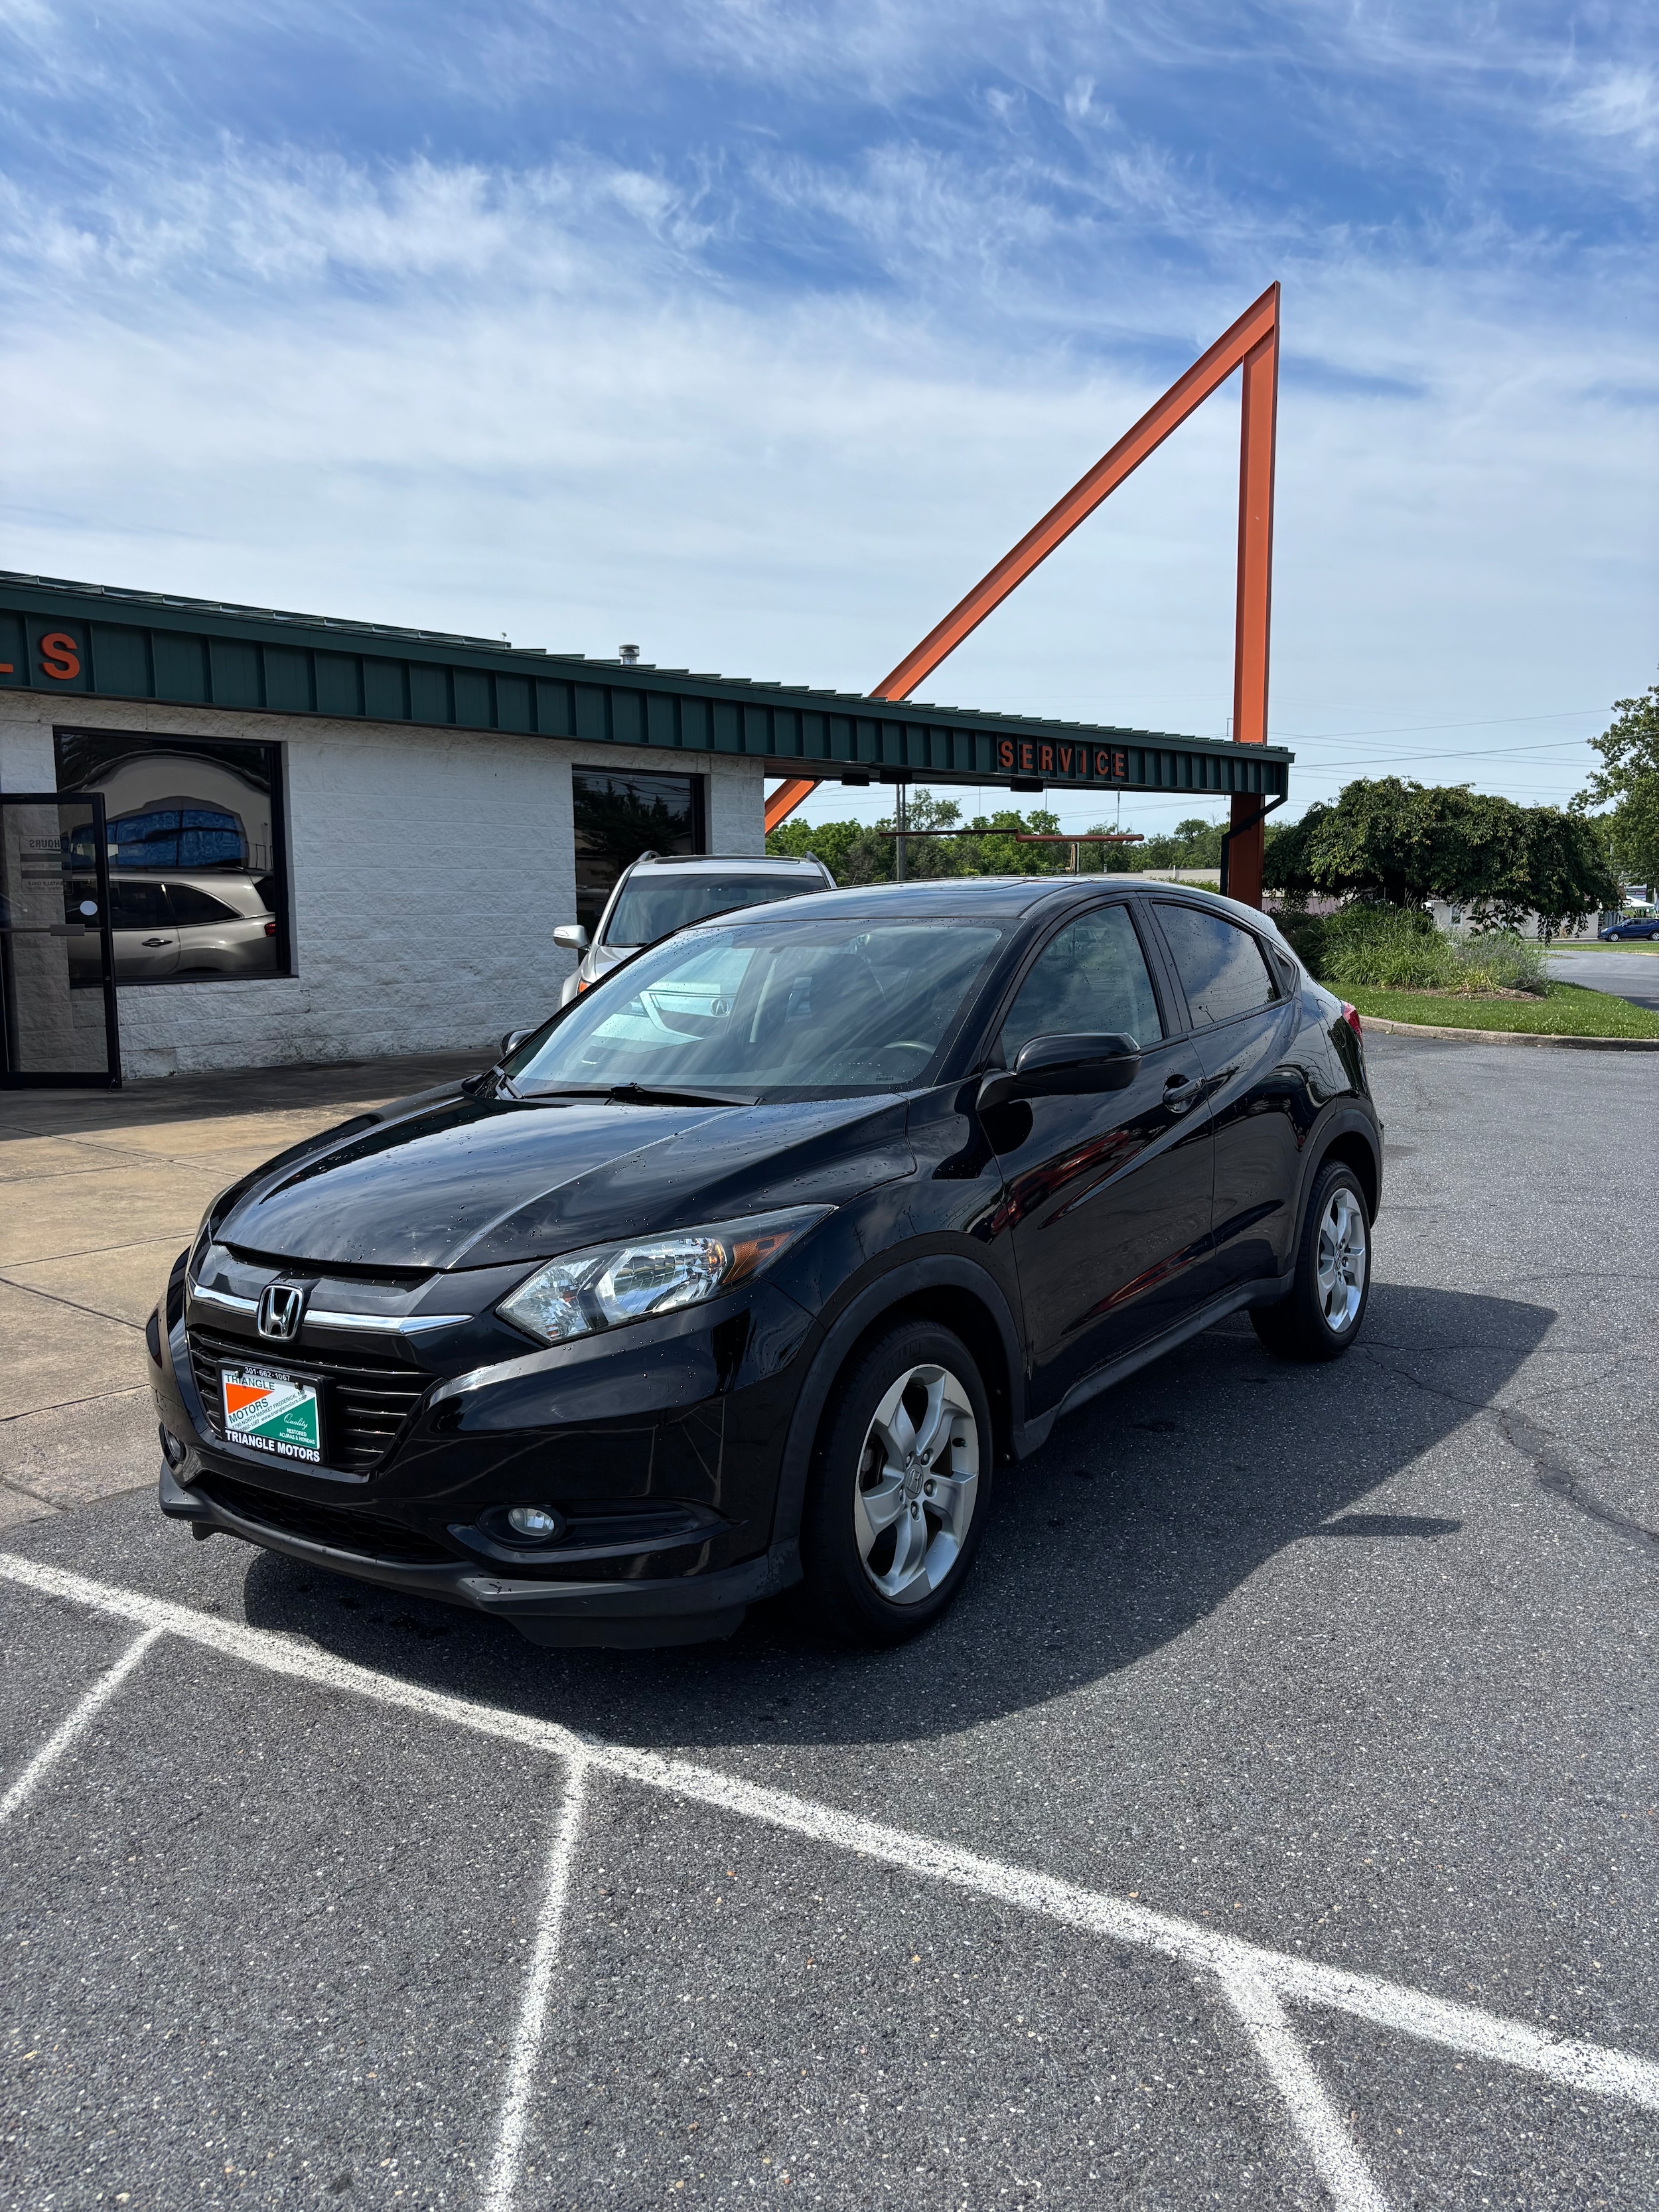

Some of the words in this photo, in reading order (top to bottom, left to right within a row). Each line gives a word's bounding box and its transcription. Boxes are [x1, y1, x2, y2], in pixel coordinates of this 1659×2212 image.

[0, 632, 80, 680] S
[1000, 741, 1125, 776] SERVICE
[225, 1374, 275, 1390] TRIANGLE
[228, 1398, 269, 1424] MOTORS
[242, 1414, 256, 1425] NORTH
[256, 1405, 273, 1418] MARKET
[273, 1394, 297, 1408] FREDERICK,
[283, 1413, 308, 1430] Quality
[286, 1428, 307, 1437] RESTORED
[299, 1436, 315, 1445] HONDAS
[225, 1430, 275, 1451] TRIANGLE
[277, 1441, 320, 1463] MOTORS
